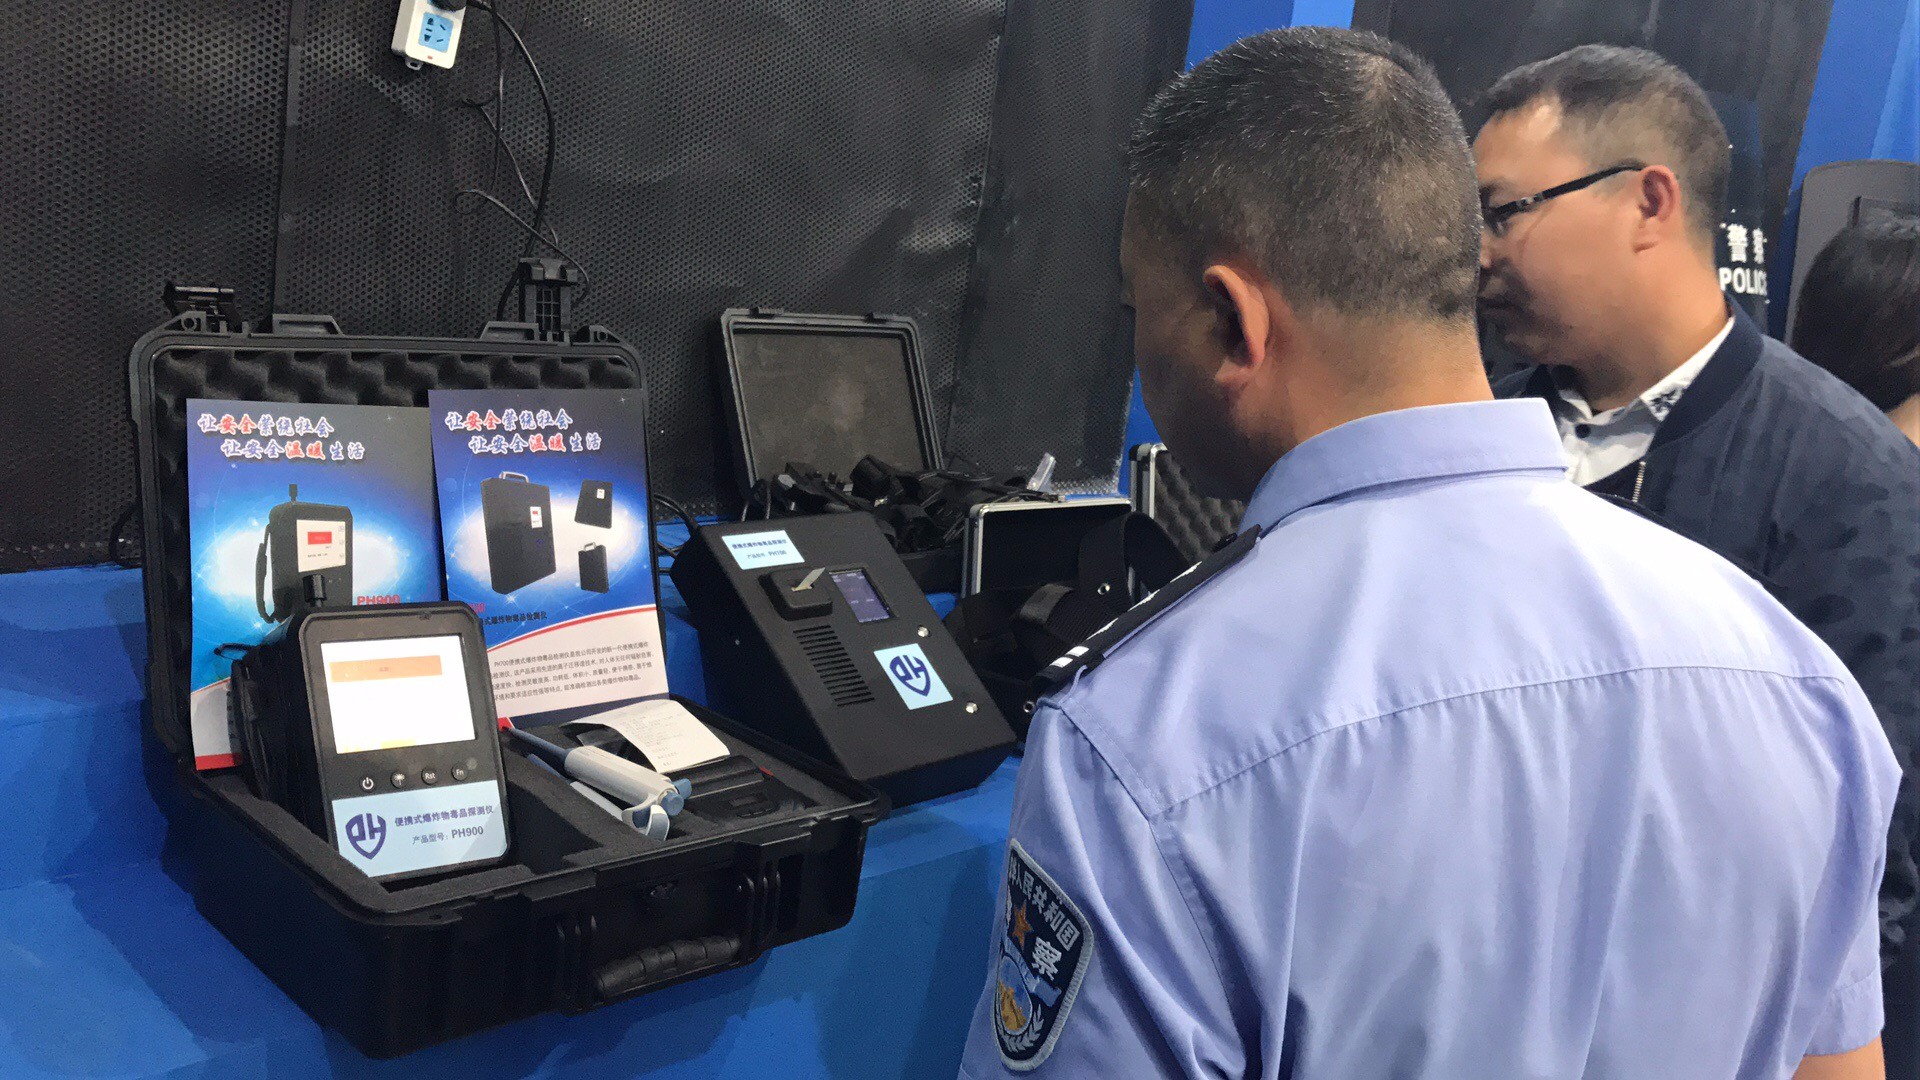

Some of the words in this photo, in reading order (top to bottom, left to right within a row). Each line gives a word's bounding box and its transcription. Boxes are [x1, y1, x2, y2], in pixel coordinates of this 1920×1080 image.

[220, 439, 365, 460] 让安全温暖生活
[468, 432, 602, 454] 让安全温暖生活
[424, 772, 436, 780] Rst
[394, 805, 494, 827] 便携式爆炸物毒品探测仪
[451, 826, 484, 839] PH900
